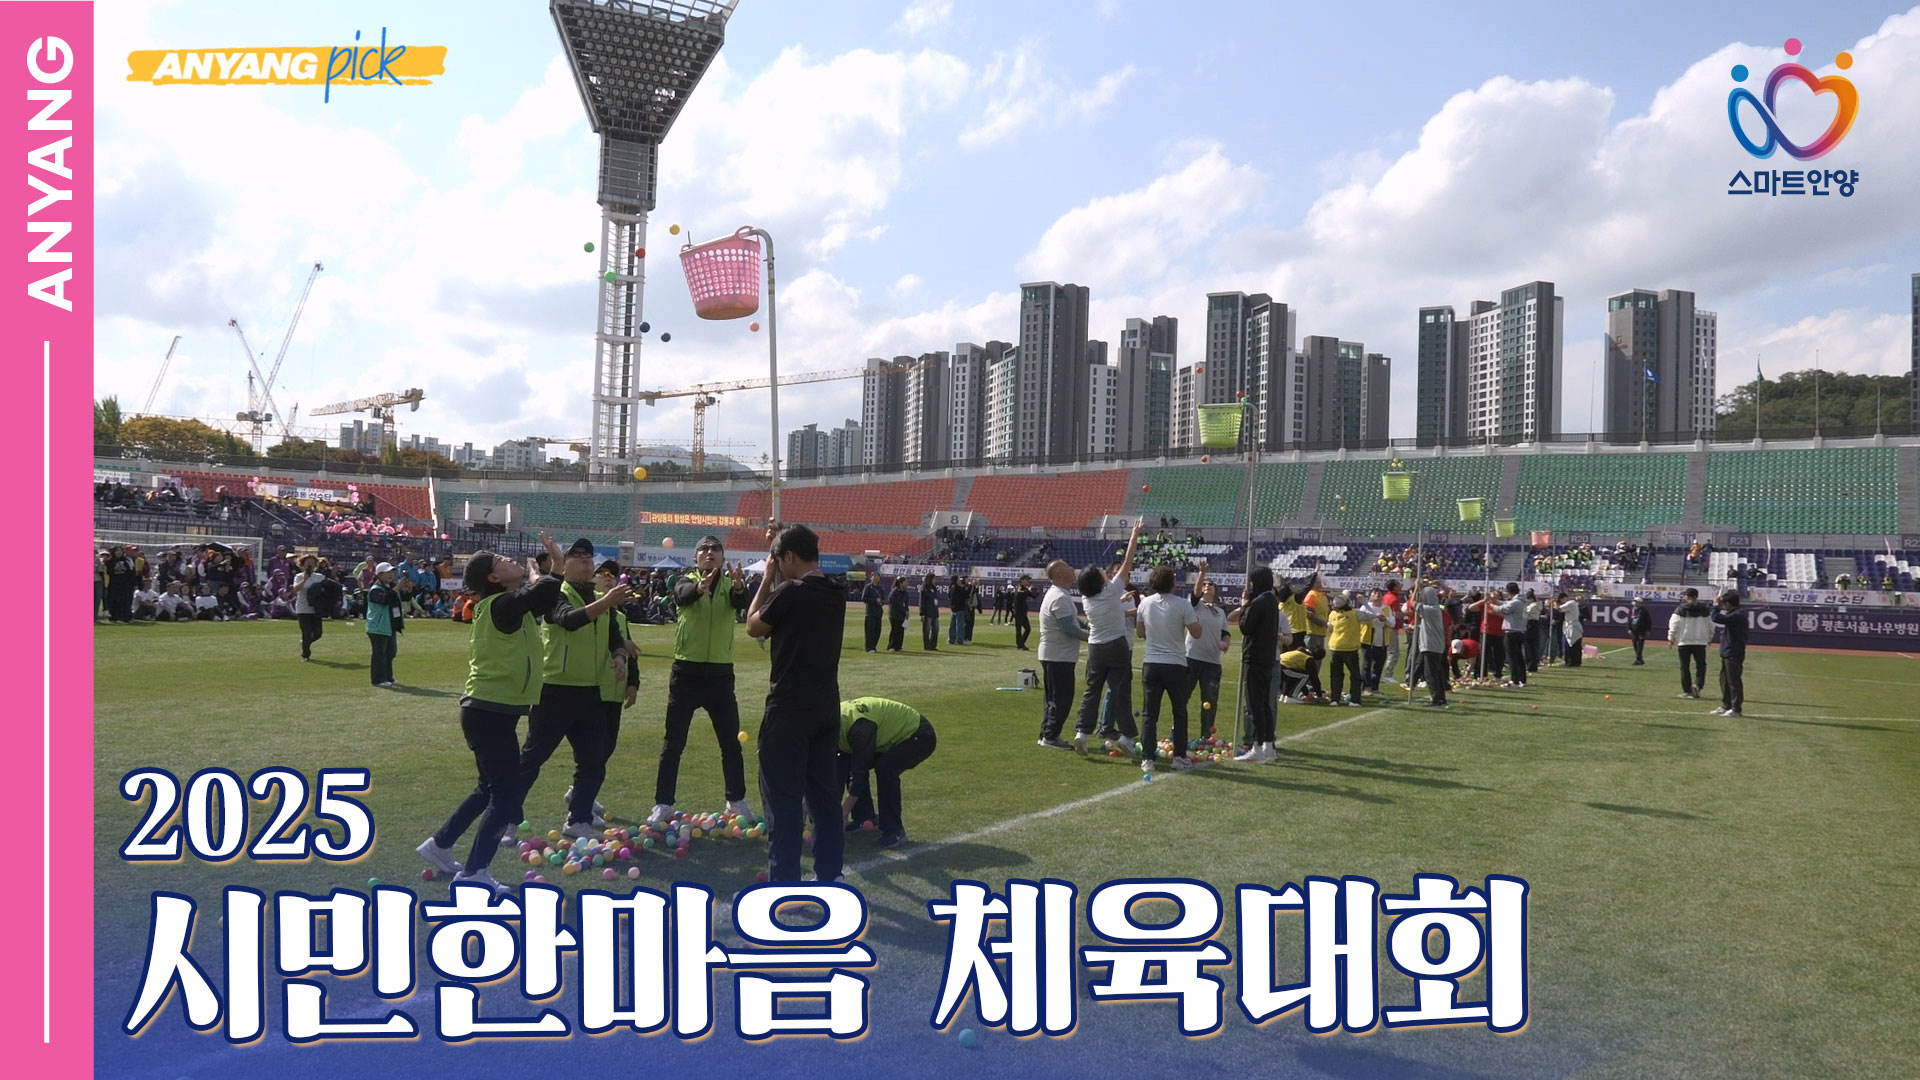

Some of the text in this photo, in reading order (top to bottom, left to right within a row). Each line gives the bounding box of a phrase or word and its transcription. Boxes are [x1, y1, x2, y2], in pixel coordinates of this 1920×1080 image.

[482, 508, 493, 519] 7
[950, 515, 960, 524] 8
[1119, 519, 1128, 528] 9
[1570, 534, 1589, 544] R20
[1729, 536, 1749, 545] R21
[1779, 592, 1865, 605] 귀인동 선수단
[1820, 619, 1920, 636] 평촌서울나우병원
